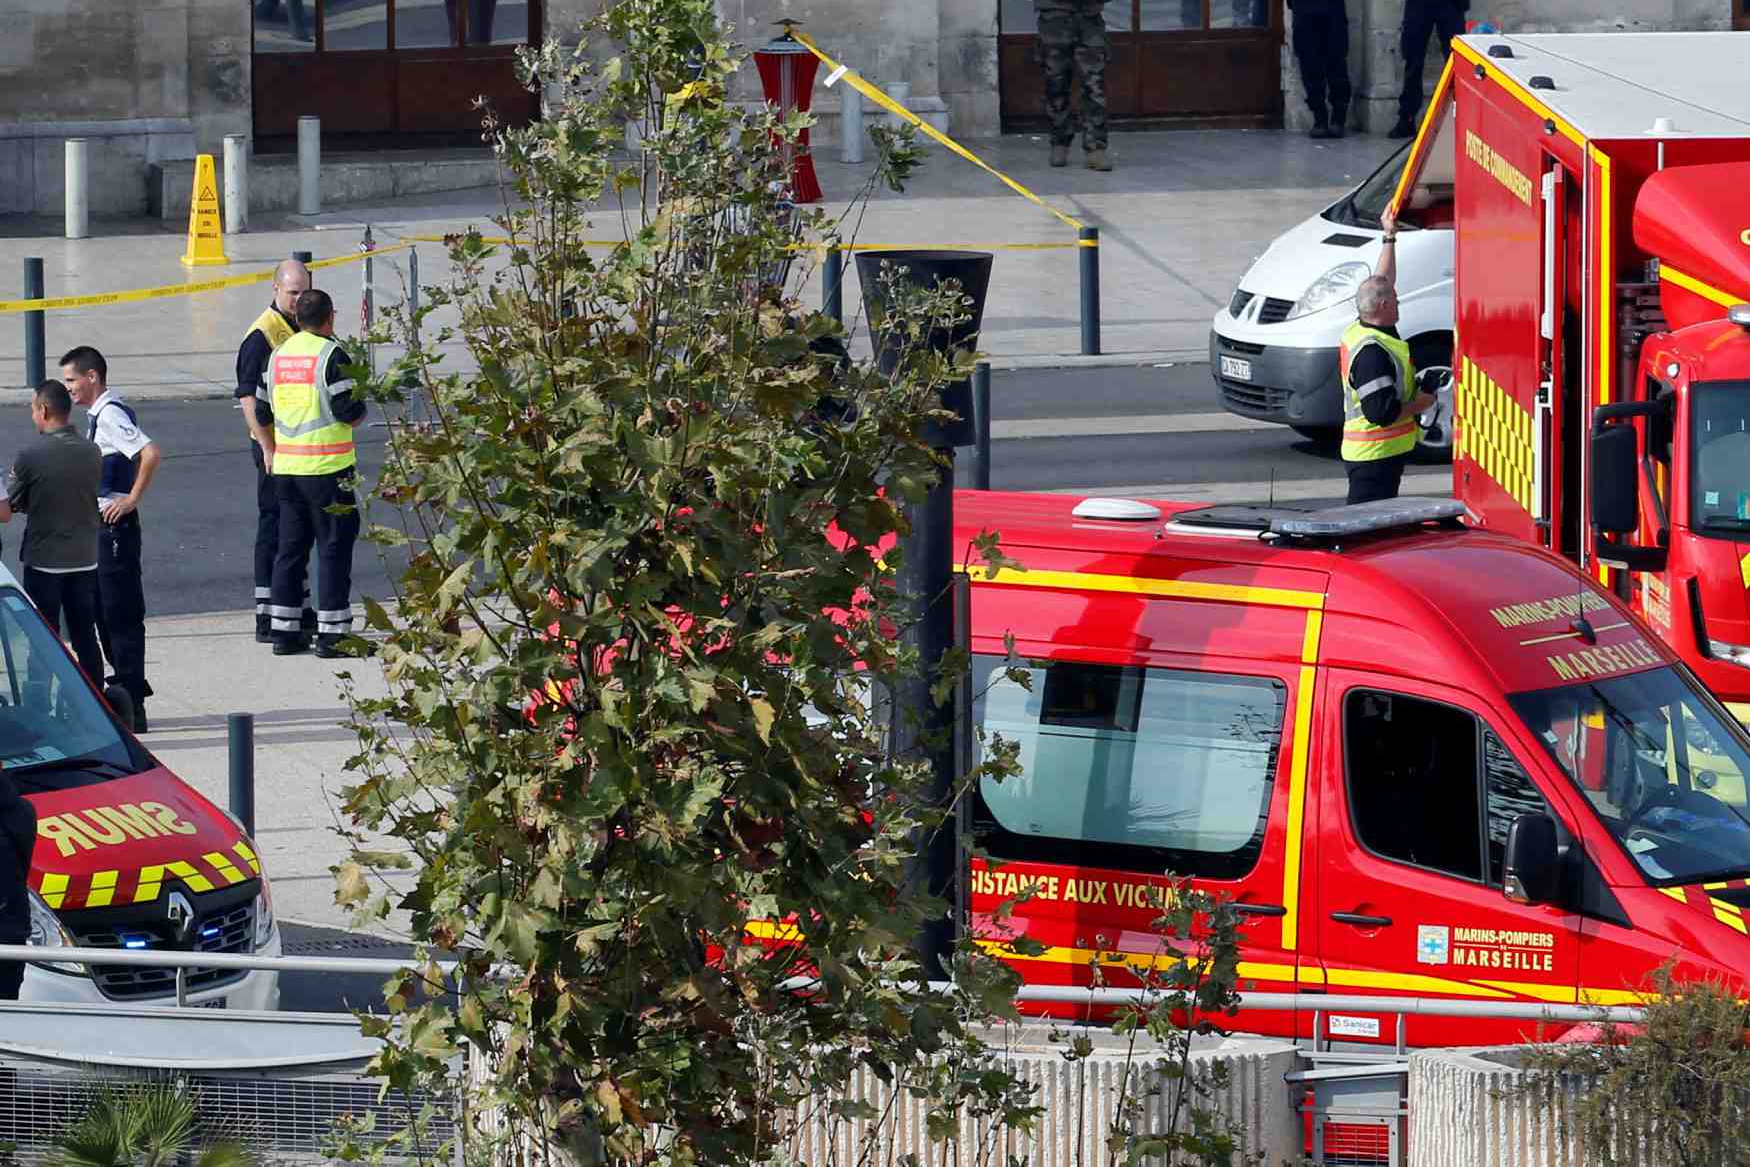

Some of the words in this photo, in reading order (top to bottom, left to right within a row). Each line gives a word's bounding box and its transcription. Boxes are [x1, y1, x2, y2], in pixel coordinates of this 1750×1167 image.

[1547, 639, 1664, 681] MARSEILLE
[1063, 879, 1107, 905] AUX
[1454, 927, 1554, 947] MARINS-POMPIERS
[1453, 948, 1553, 971] MARSEILLE
